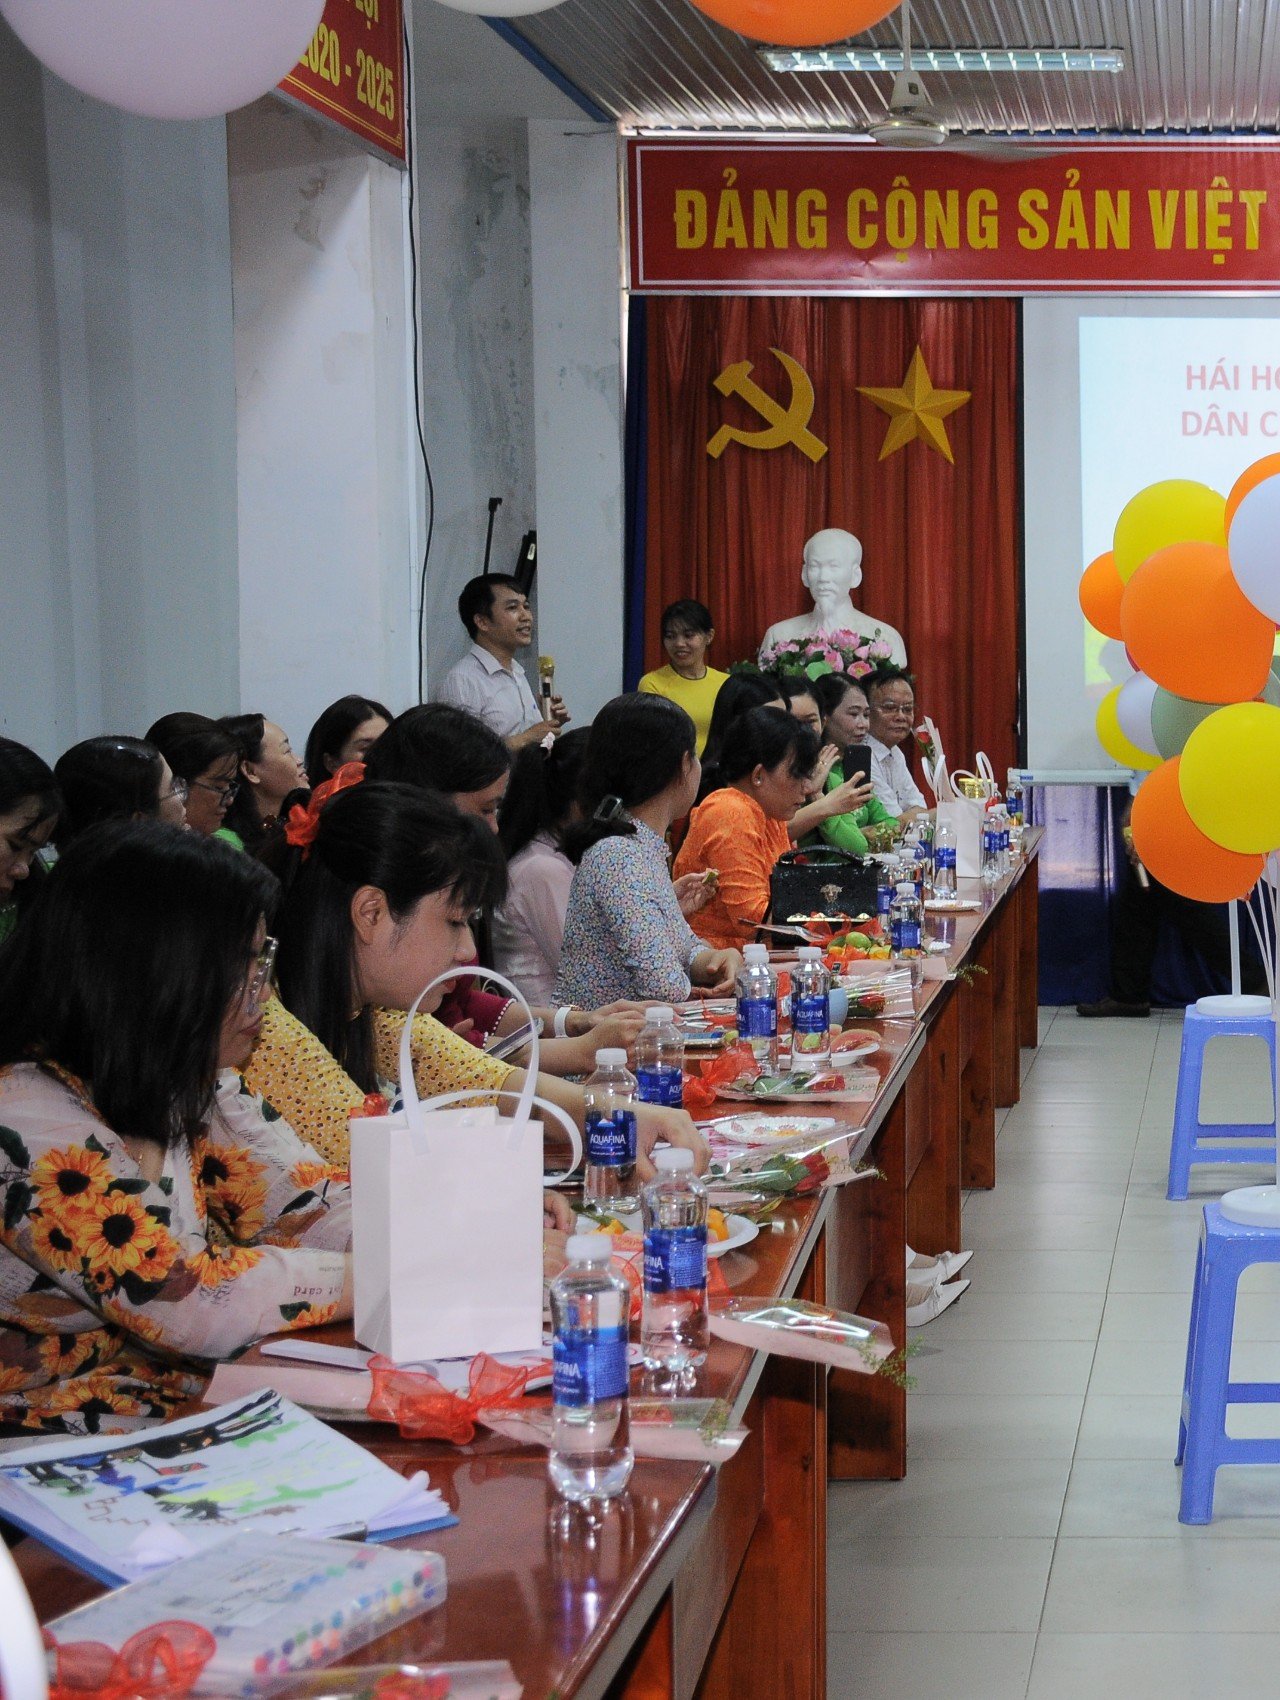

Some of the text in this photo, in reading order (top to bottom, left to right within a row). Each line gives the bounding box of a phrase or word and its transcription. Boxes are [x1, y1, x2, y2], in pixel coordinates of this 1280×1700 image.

[356, 48, 394, 121] 2025
[674, 168, 828, 249] ĐẢNG
[846, 175, 999, 263] CỘNG
[1017, 168, 1131, 249] SẢN
[1147, 177, 1267, 264] VIỆT
[1185, 357, 1240, 391] HÁI
[1181, 403, 1249, 437] DÂN
[589, 1133, 627, 1146] AQUAFINA
